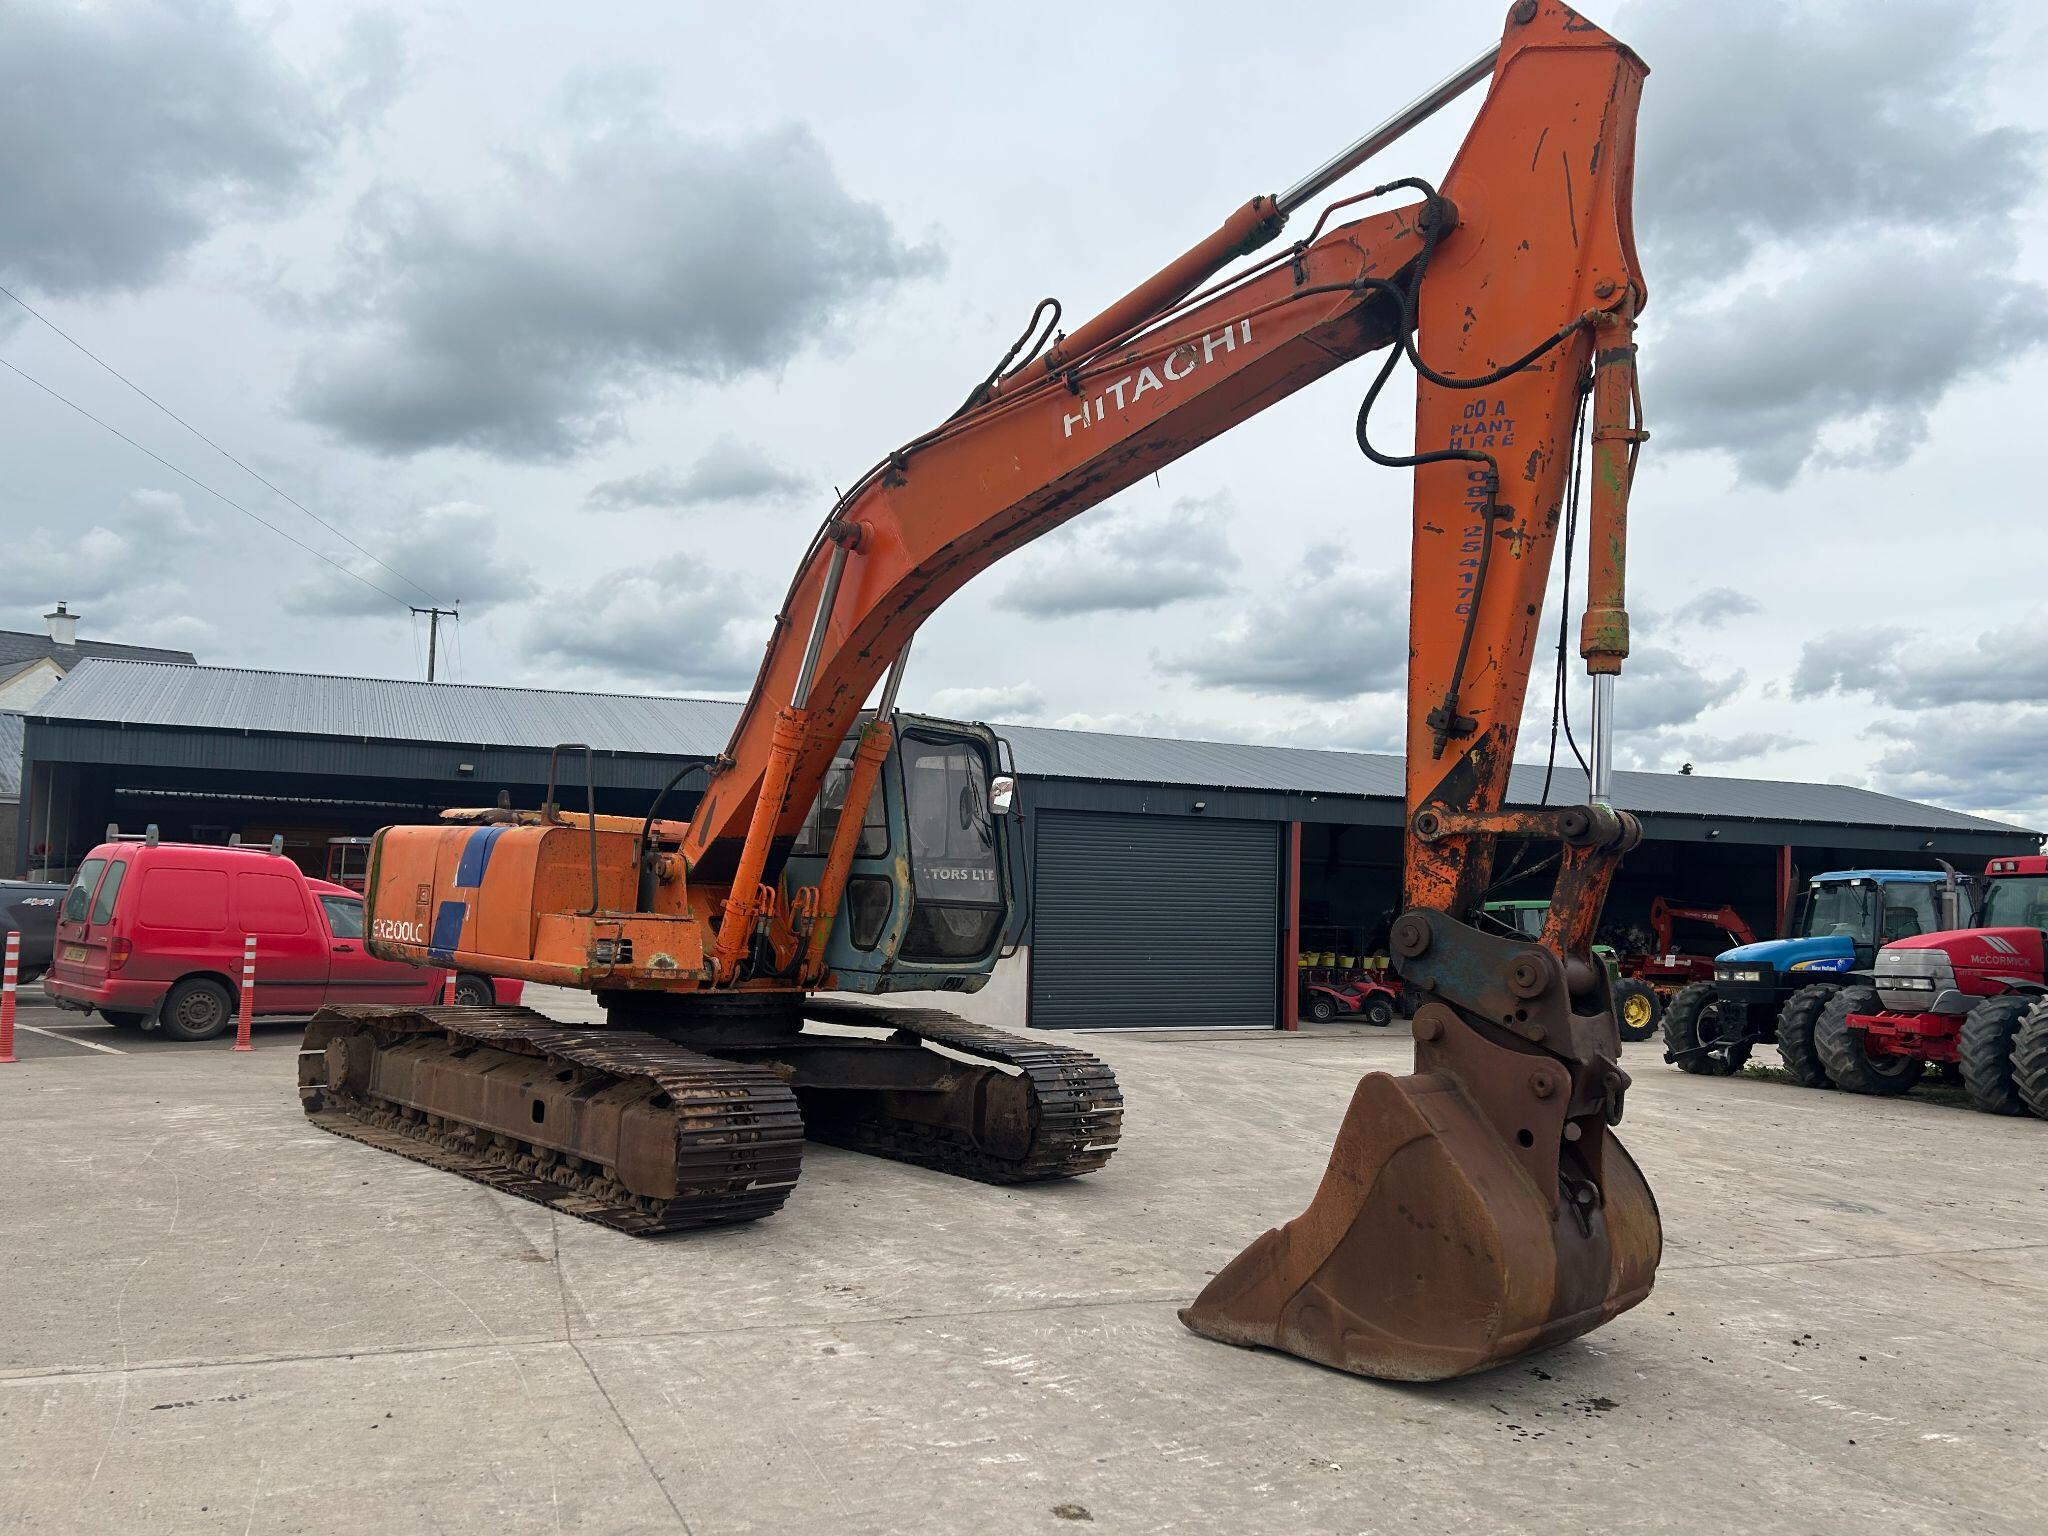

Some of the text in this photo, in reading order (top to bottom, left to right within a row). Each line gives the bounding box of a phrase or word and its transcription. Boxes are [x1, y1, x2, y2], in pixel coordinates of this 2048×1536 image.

[1063, 318, 1252, 438] HITACHI
[1450, 419, 1516, 436] PLANT
[1449, 432, 1515, 450] HIRE
[372, 918, 423, 943] EX200LC
